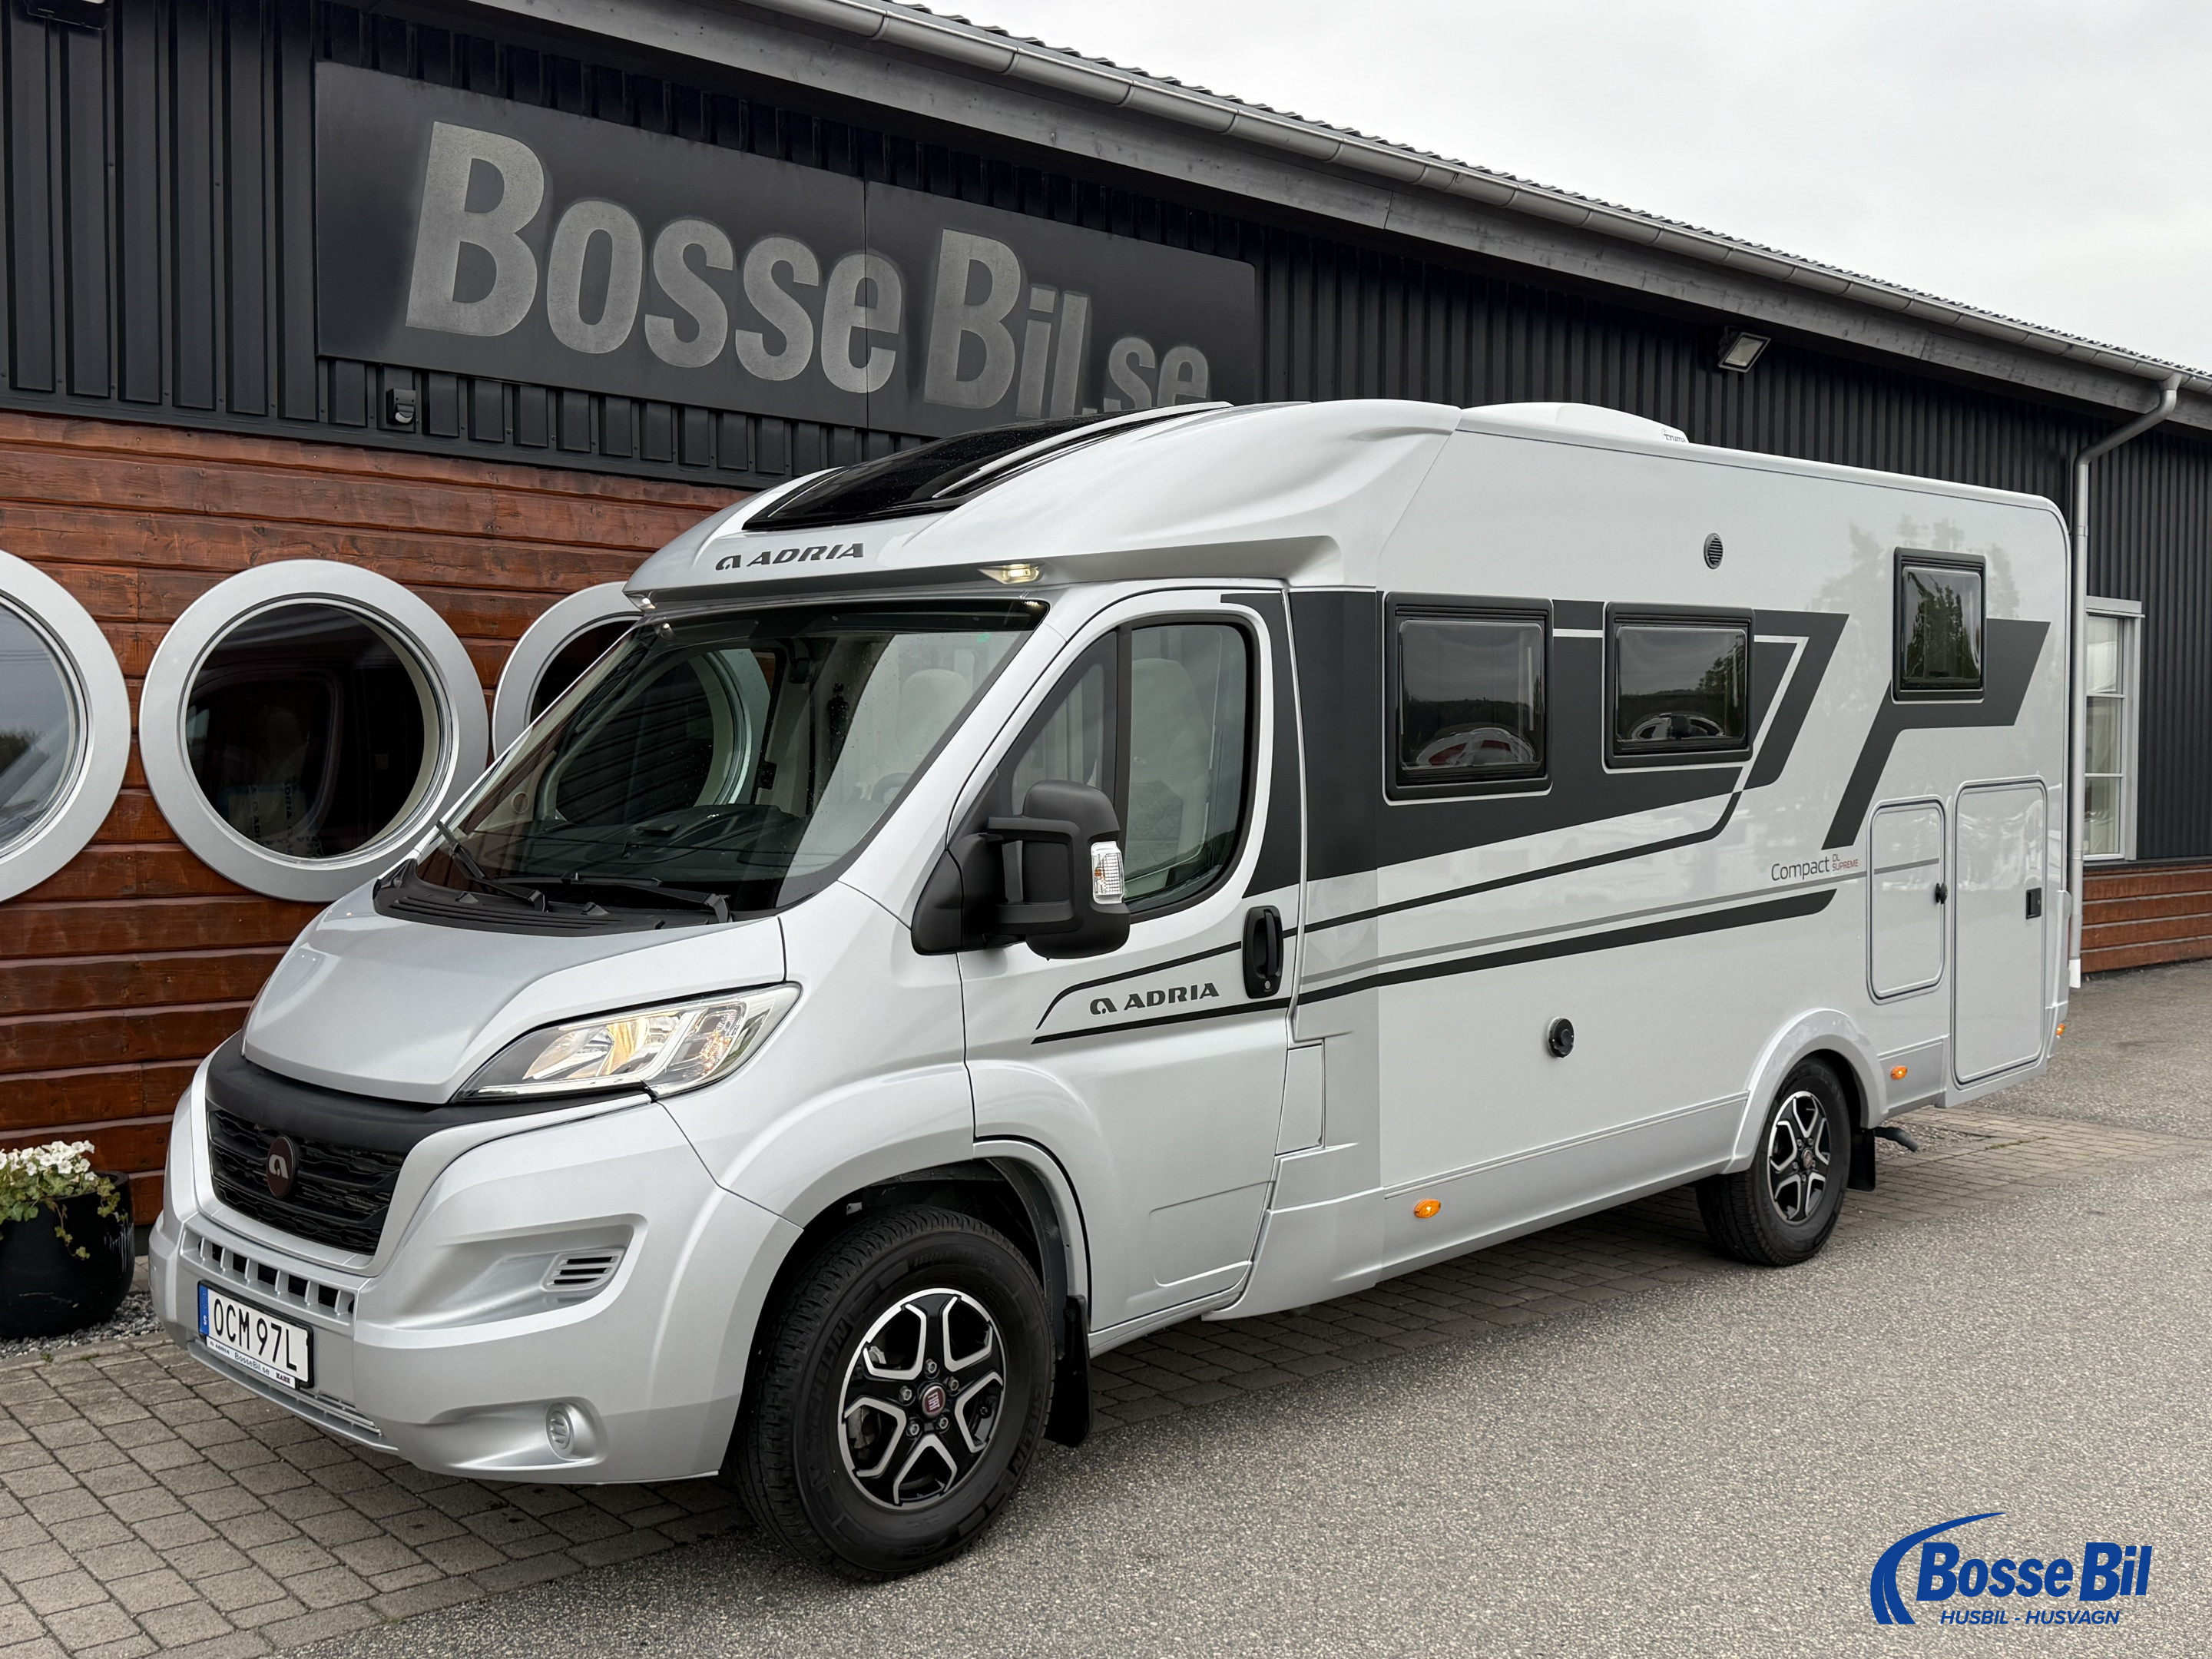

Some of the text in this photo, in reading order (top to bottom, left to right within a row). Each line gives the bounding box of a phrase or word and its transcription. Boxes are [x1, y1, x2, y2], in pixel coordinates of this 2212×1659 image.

[405, 120, 907, 395] Bosse
[746, 542, 865, 568] ADRIA
[1771, 856, 1830, 882] Compact
[1832, 853, 1840, 863] DL
[1832, 859, 1859, 872] SUPREME
[1124, 982, 1220, 1011] ADRIA
[214, 1297, 297, 1373] OCM 97L
[927, 1391, 940, 1411] FIAT
